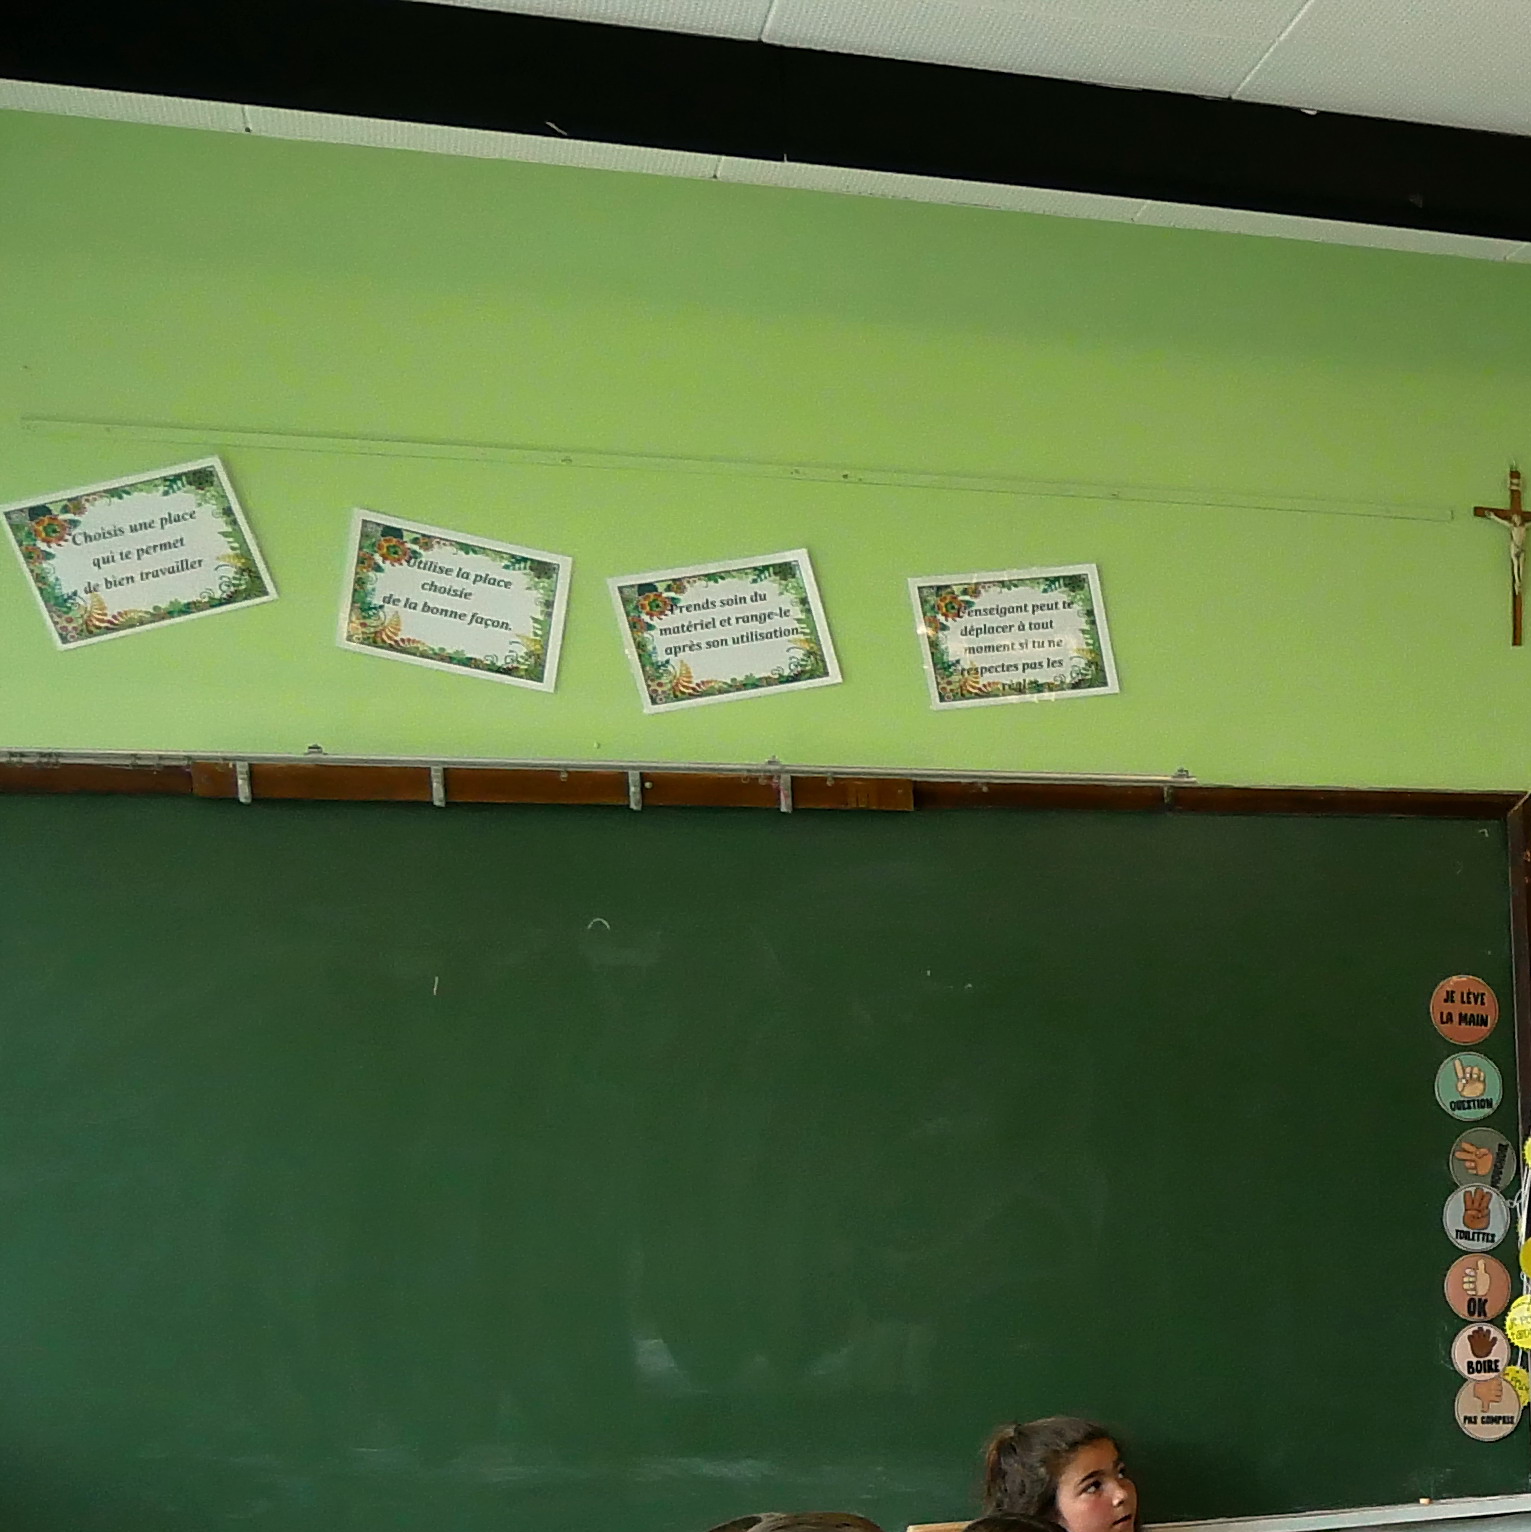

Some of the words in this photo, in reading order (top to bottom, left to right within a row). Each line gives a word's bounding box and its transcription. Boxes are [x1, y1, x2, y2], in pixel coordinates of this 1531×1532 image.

[72, 525, 125, 546] Choisis
[129, 519, 156, 533] une
[160, 509, 196, 530] place
[92, 550, 116, 569] qui
[119, 549, 132, 562] te
[136, 536, 185, 561] permet
[83, 581, 100, 595] de
[104, 575, 135, 590] bien
[140, 558, 203, 581] travailler
[407, 557, 454, 577] Utilise
[456, 567, 470, 580] la
[472, 571, 513, 590] place
[421, 581, 473, 600] choisie
[382, 593, 401, 607] de
[403, 597, 418, 611] la
[421, 602, 467, 621] bonne
[467, 612, 512, 631] façon.
[669, 598, 717, 616] Prends
[720, 594, 747, 608] soin
[750, 591, 767, 603] du
[1031, 600, 1056, 615] peut
[1057, 600, 1074, 610] te
[659, 617, 717, 636] matériel
[719, 617, 732, 627] et
[735, 606, 791, 625] range-le
[960, 622, 1015, 638] déplacer
[1017, 620, 1027, 632] à
[1028, 619, 1054, 631] tout
[664, 639, 703, 657] après
[705, 637, 728, 650] son
[964, 641, 1016, 655] moment
[1019, 639, 1029, 650] si
[1031, 639, 1045, 649] tu
[1047, 638, 1063, 648] ne
[960, 661, 1019, 676] respectes
[1022, 660, 1044, 673] pas
[1046, 657, 1064, 668] les
[1444, 990, 1455, 1004] JE
[1440, 1011, 1453, 1025] LA
[1458, 1012, 1489, 1027] MAIN
[1450, 1098, 1493, 1111] QUESTION
[1455, 1229, 1497, 1243] TOILETTES
[1467, 1298, 1488, 1317] OK
[1467, 1360, 1500, 1375] BOIRE
[1463, 1415, 1478, 1425] PAS
